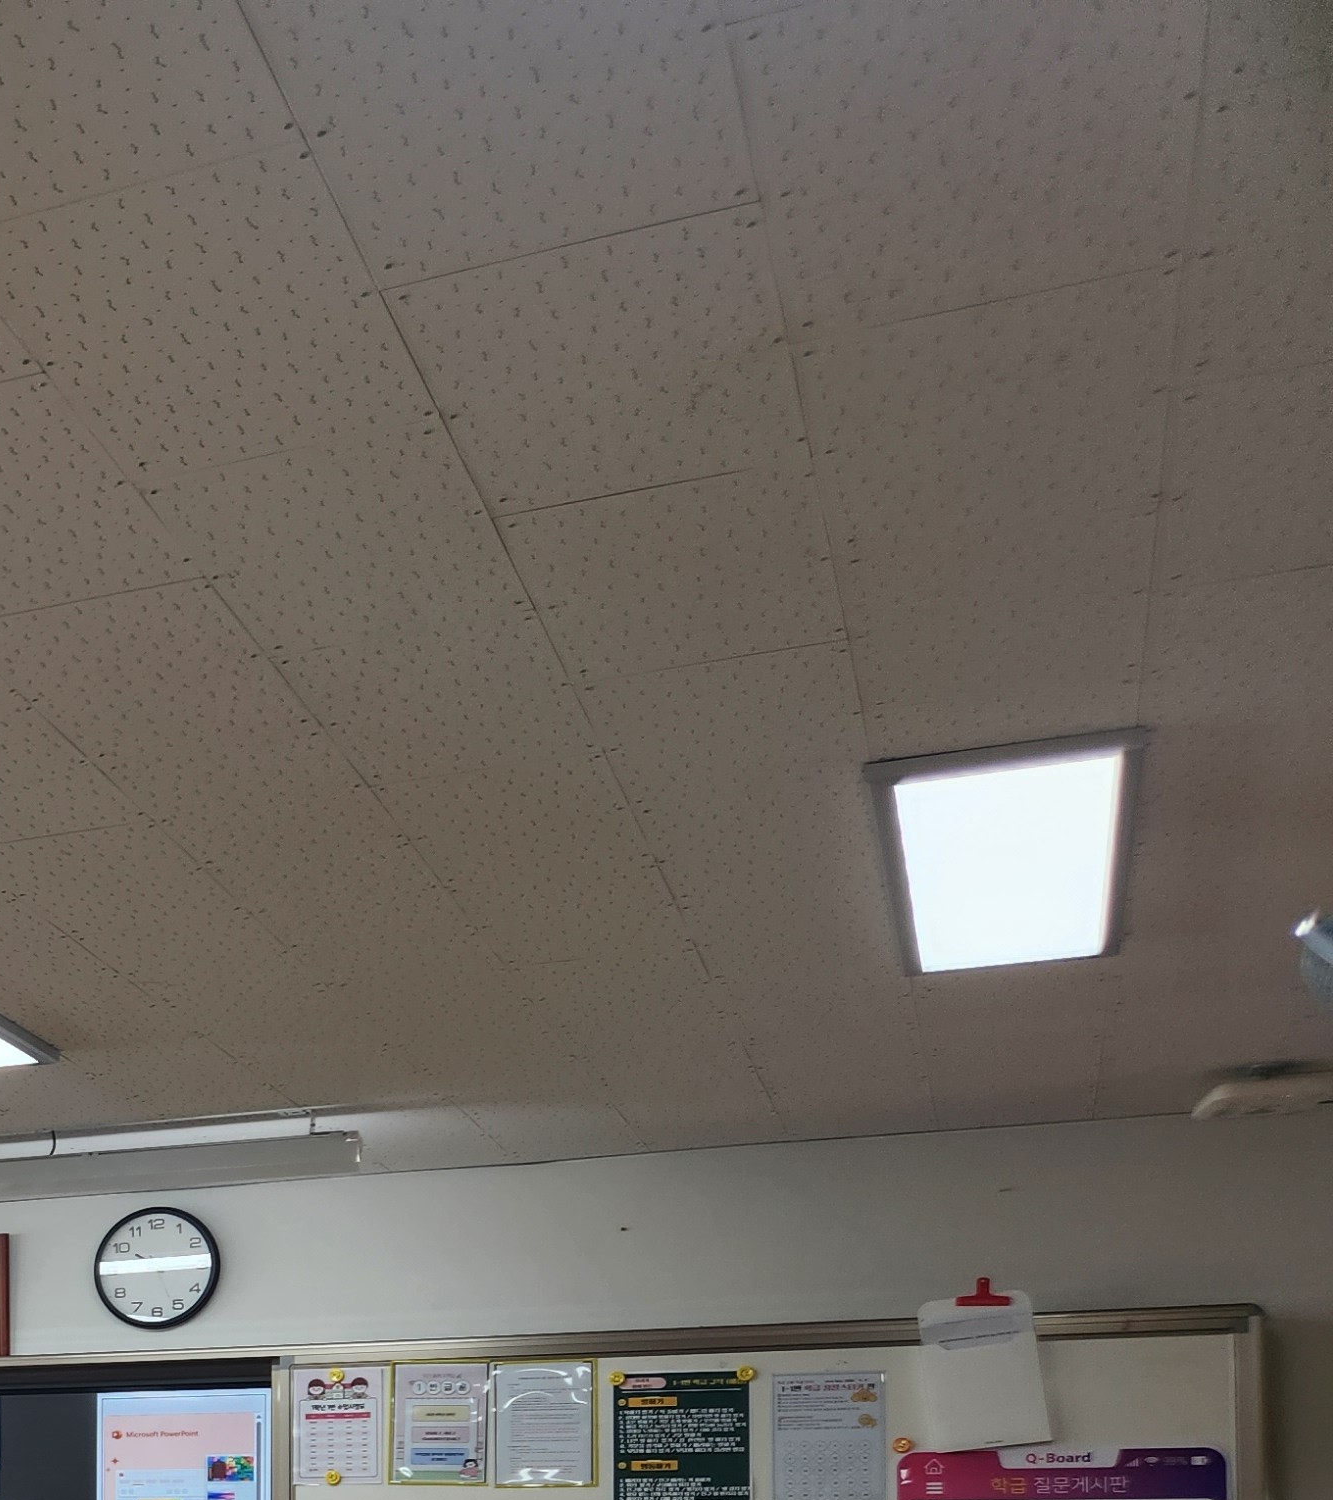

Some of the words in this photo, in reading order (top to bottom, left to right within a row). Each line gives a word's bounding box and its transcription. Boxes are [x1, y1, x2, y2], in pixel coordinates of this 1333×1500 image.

[148, 1218, 165, 1230] 12
[176, 1223, 183, 1234] 1
[129, 1226, 142, 1238] 11
[113, 1242, 130, 1253] 10
[189, 1237, 202, 1248] 2
[114, 1288, 126, 1298] 8
[189, 1283, 201, 1294] 4
[131, 1302, 143, 1312] 7
[172, 1299, 184, 1310] 5
[151, 1307, 163, 1317] 6
[160, 1430, 199, 1438] PowerPoint
[1025, 1453, 1091, 1465] Q-Board
[990, 1478, 1027, 1495] 학급
[1034, 1476, 1130, 1494] 질문게시판
